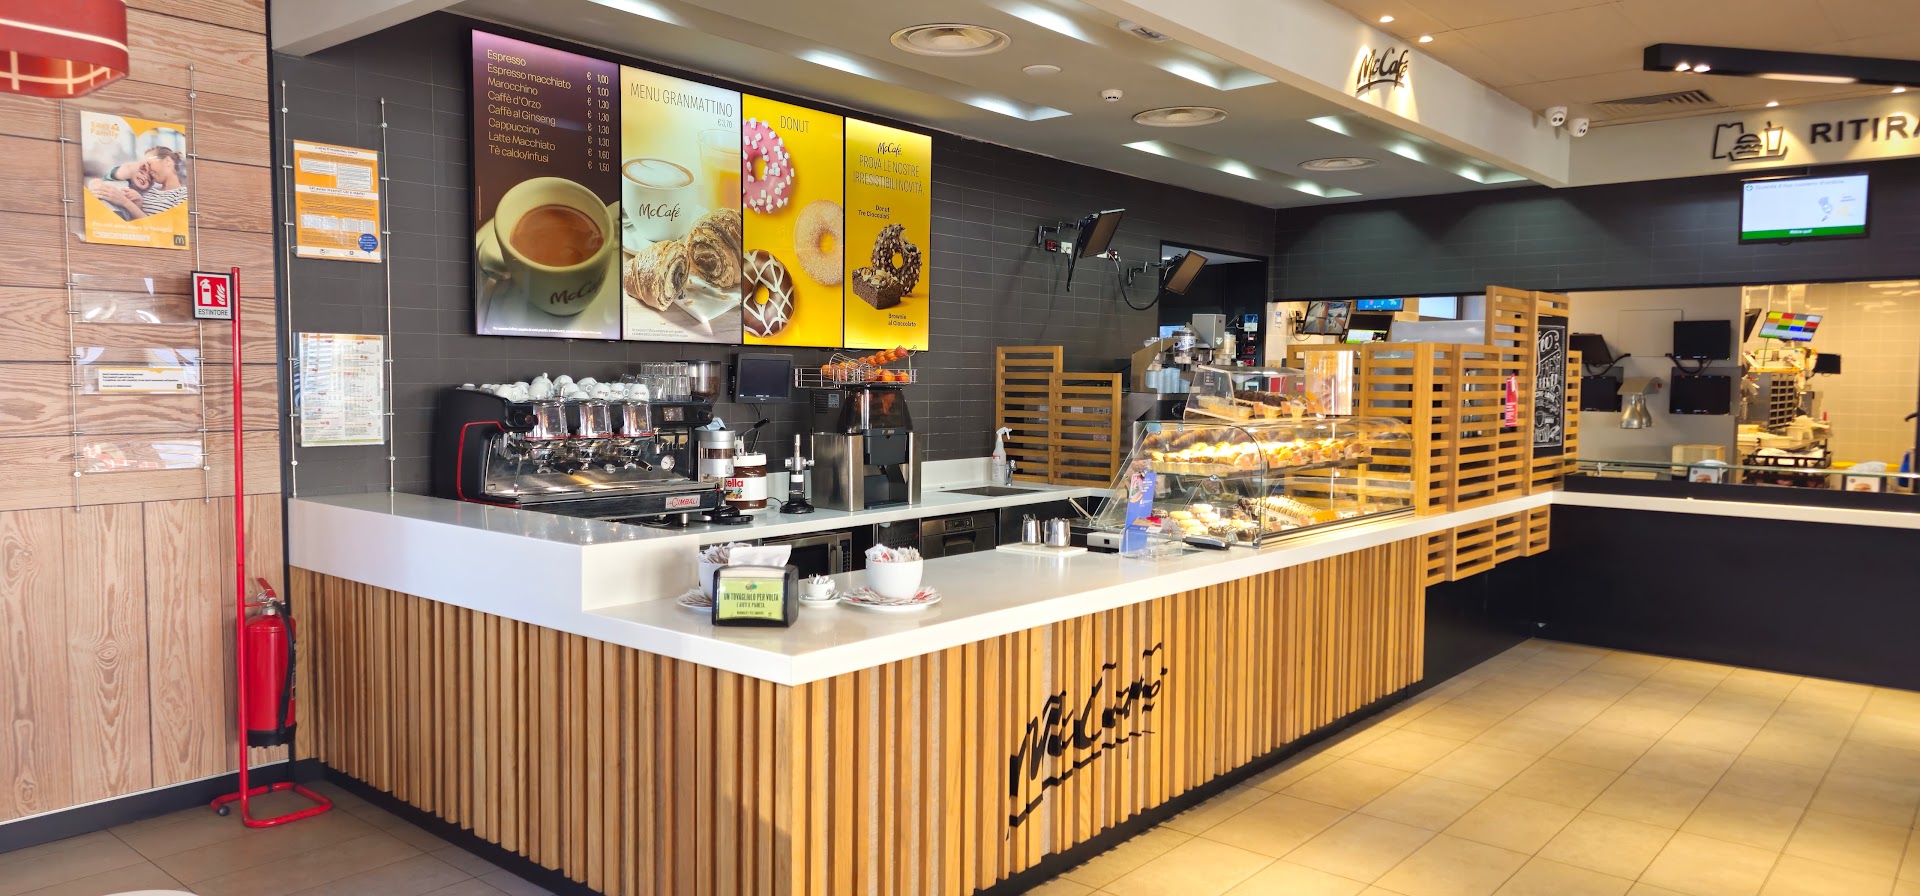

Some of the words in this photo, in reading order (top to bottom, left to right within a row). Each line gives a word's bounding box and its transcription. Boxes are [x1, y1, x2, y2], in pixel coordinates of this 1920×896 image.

[488, 50, 526, 66] Espresso
[587, 72, 591, 80] €
[488, 63, 526, 80] Espresso
[528, 72, 571, 89] macchiato
[587, 85, 591, 93] €
[1357, 47, 1408, 91] McCafé
[488, 77, 538, 96] Marocchino
[588, 98, 591, 106] €
[488, 91, 512, 104] Caffè
[513, 96, 541, 109] d'Orzo
[588, 110, 592, 118] €
[630, 83, 660, 102] MENU
[663, 90, 732, 118] GRANMATTINO
[488, 104, 512, 117] Caffè
[513, 109, 520, 118] al
[522, 111, 556, 127] Ginseng
[588, 123, 592, 131] €
[780, 116, 809, 133] DONUT
[1810, 116, 1920, 144] RITIR
[488, 118, 540, 135] Cappuccino
[588, 136, 592, 144] €
[488, 131, 510, 143] Latte
[512, 136, 555, 150] Macchiato
[588, 148, 592, 156] €
[489, 144, 501, 155] Tè
[502, 149, 548, 163] caldo/infusi
[588, 161, 592, 169] €
[860, 154, 882, 169] PROVA
[884, 160, 891, 172] LE
[892, 162, 919, 177] NOSTRE
[639, 203, 680, 222] McCafé
[867, 211, 889, 219] Cioccolati
[672, 498, 698, 507] CIMBALI
